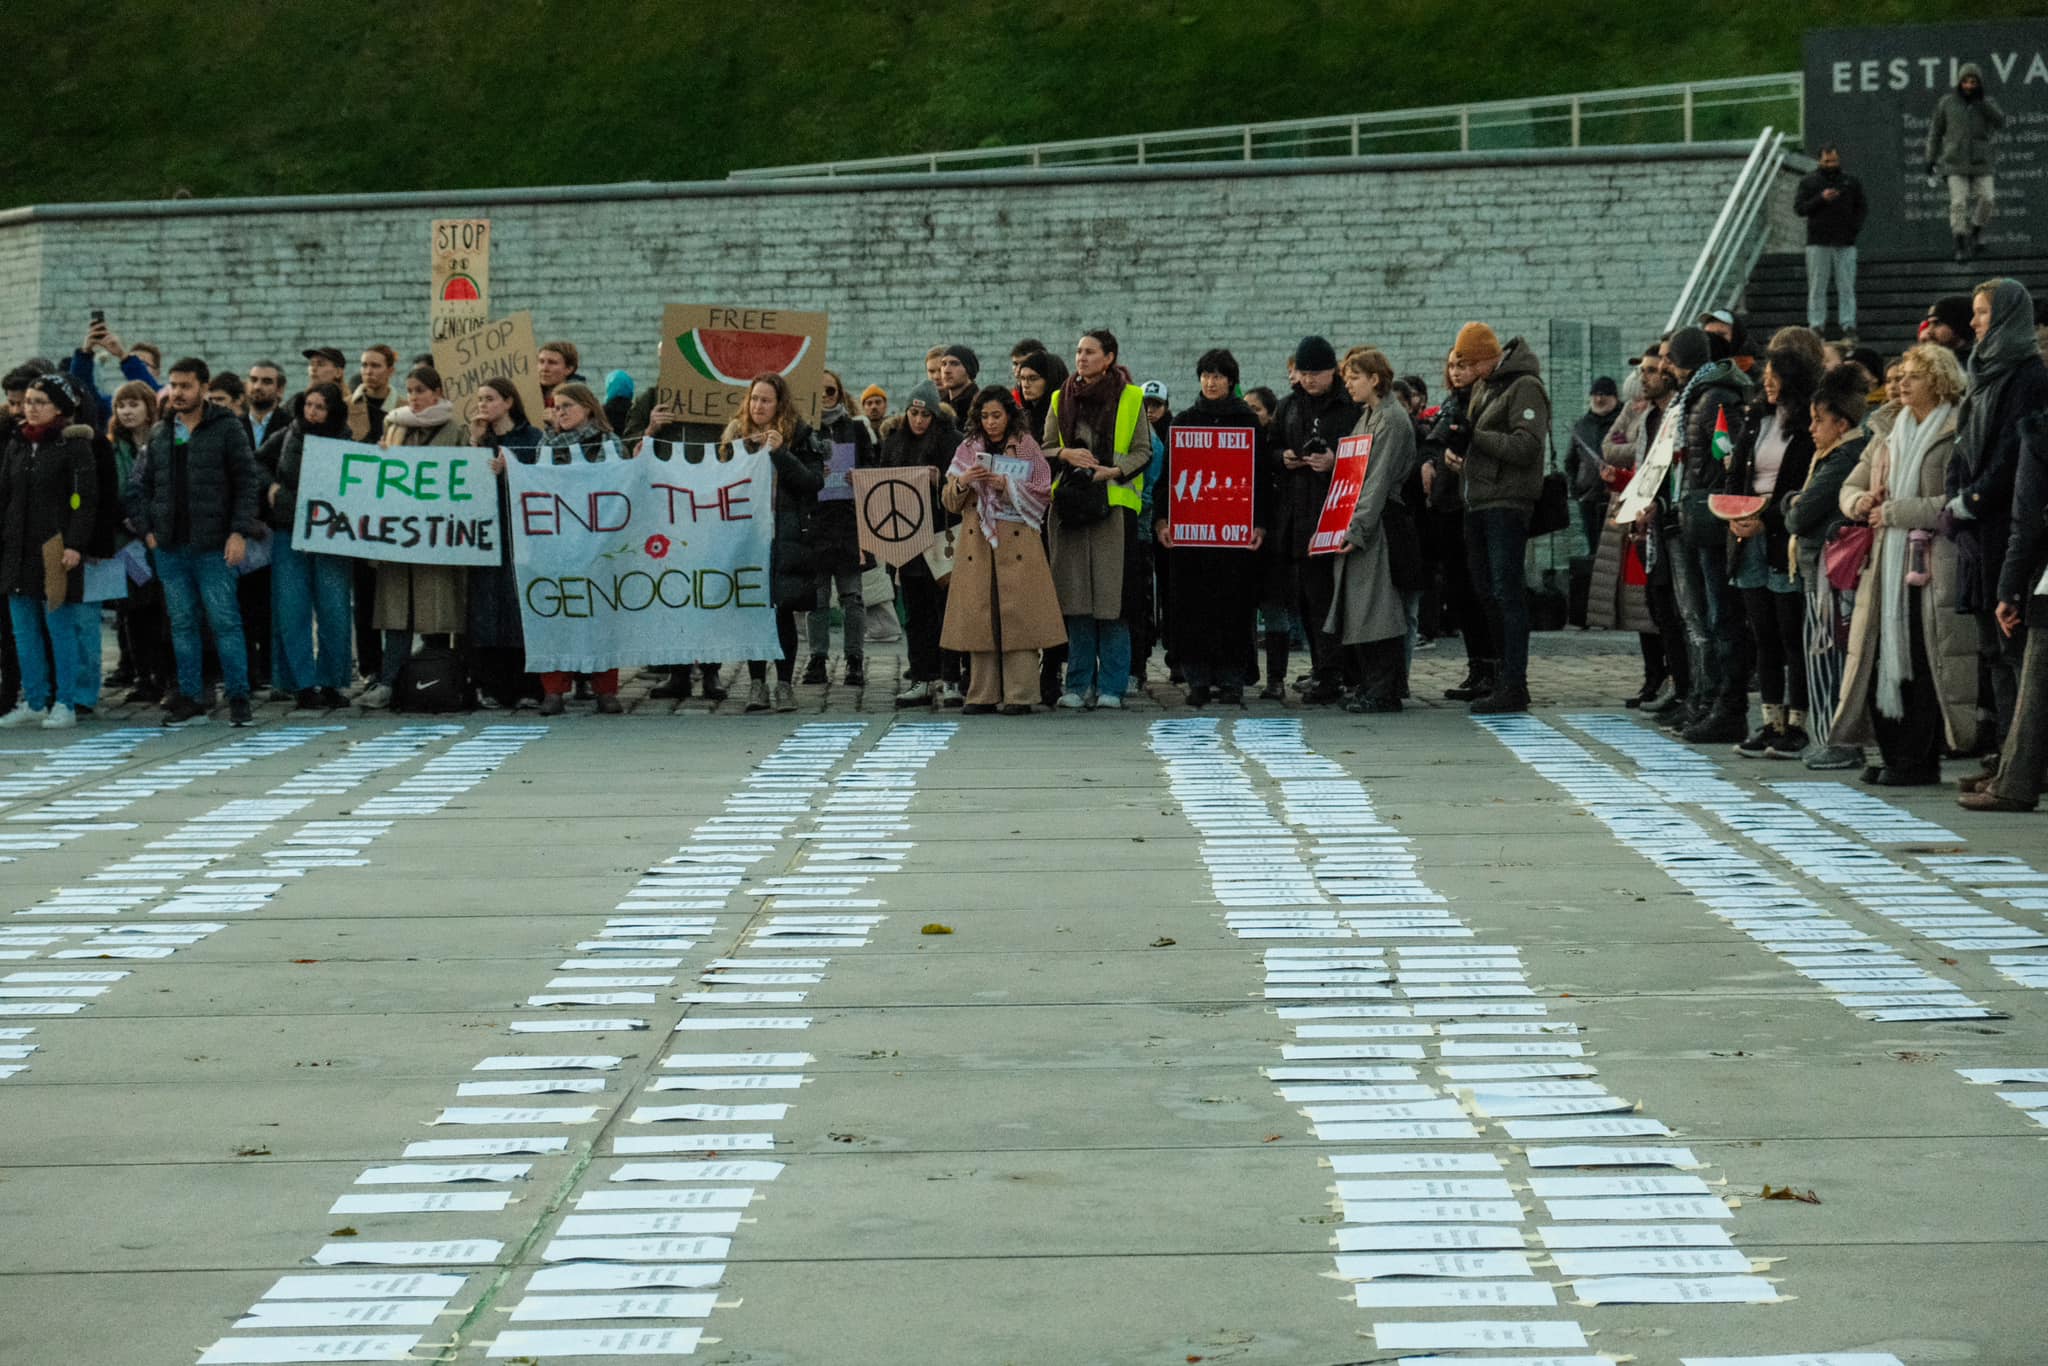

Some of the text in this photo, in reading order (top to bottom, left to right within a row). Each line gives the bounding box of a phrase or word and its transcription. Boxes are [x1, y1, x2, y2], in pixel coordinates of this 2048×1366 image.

[1832, 56, 1958, 93] EESTI
[438, 223, 486, 251] STOP
[708, 308, 777, 331] FREE
[456, 320, 514, 366] STOP
[444, 350, 530, 401] BOMBING
[1175, 431, 1251, 450] KUHU NEIL
[338, 453, 473, 502] FREE
[520, 478, 753, 536] END THE
[1174, 523, 1249, 542] MINNA ON?
[526, 565, 767, 618] GENOCIDE
